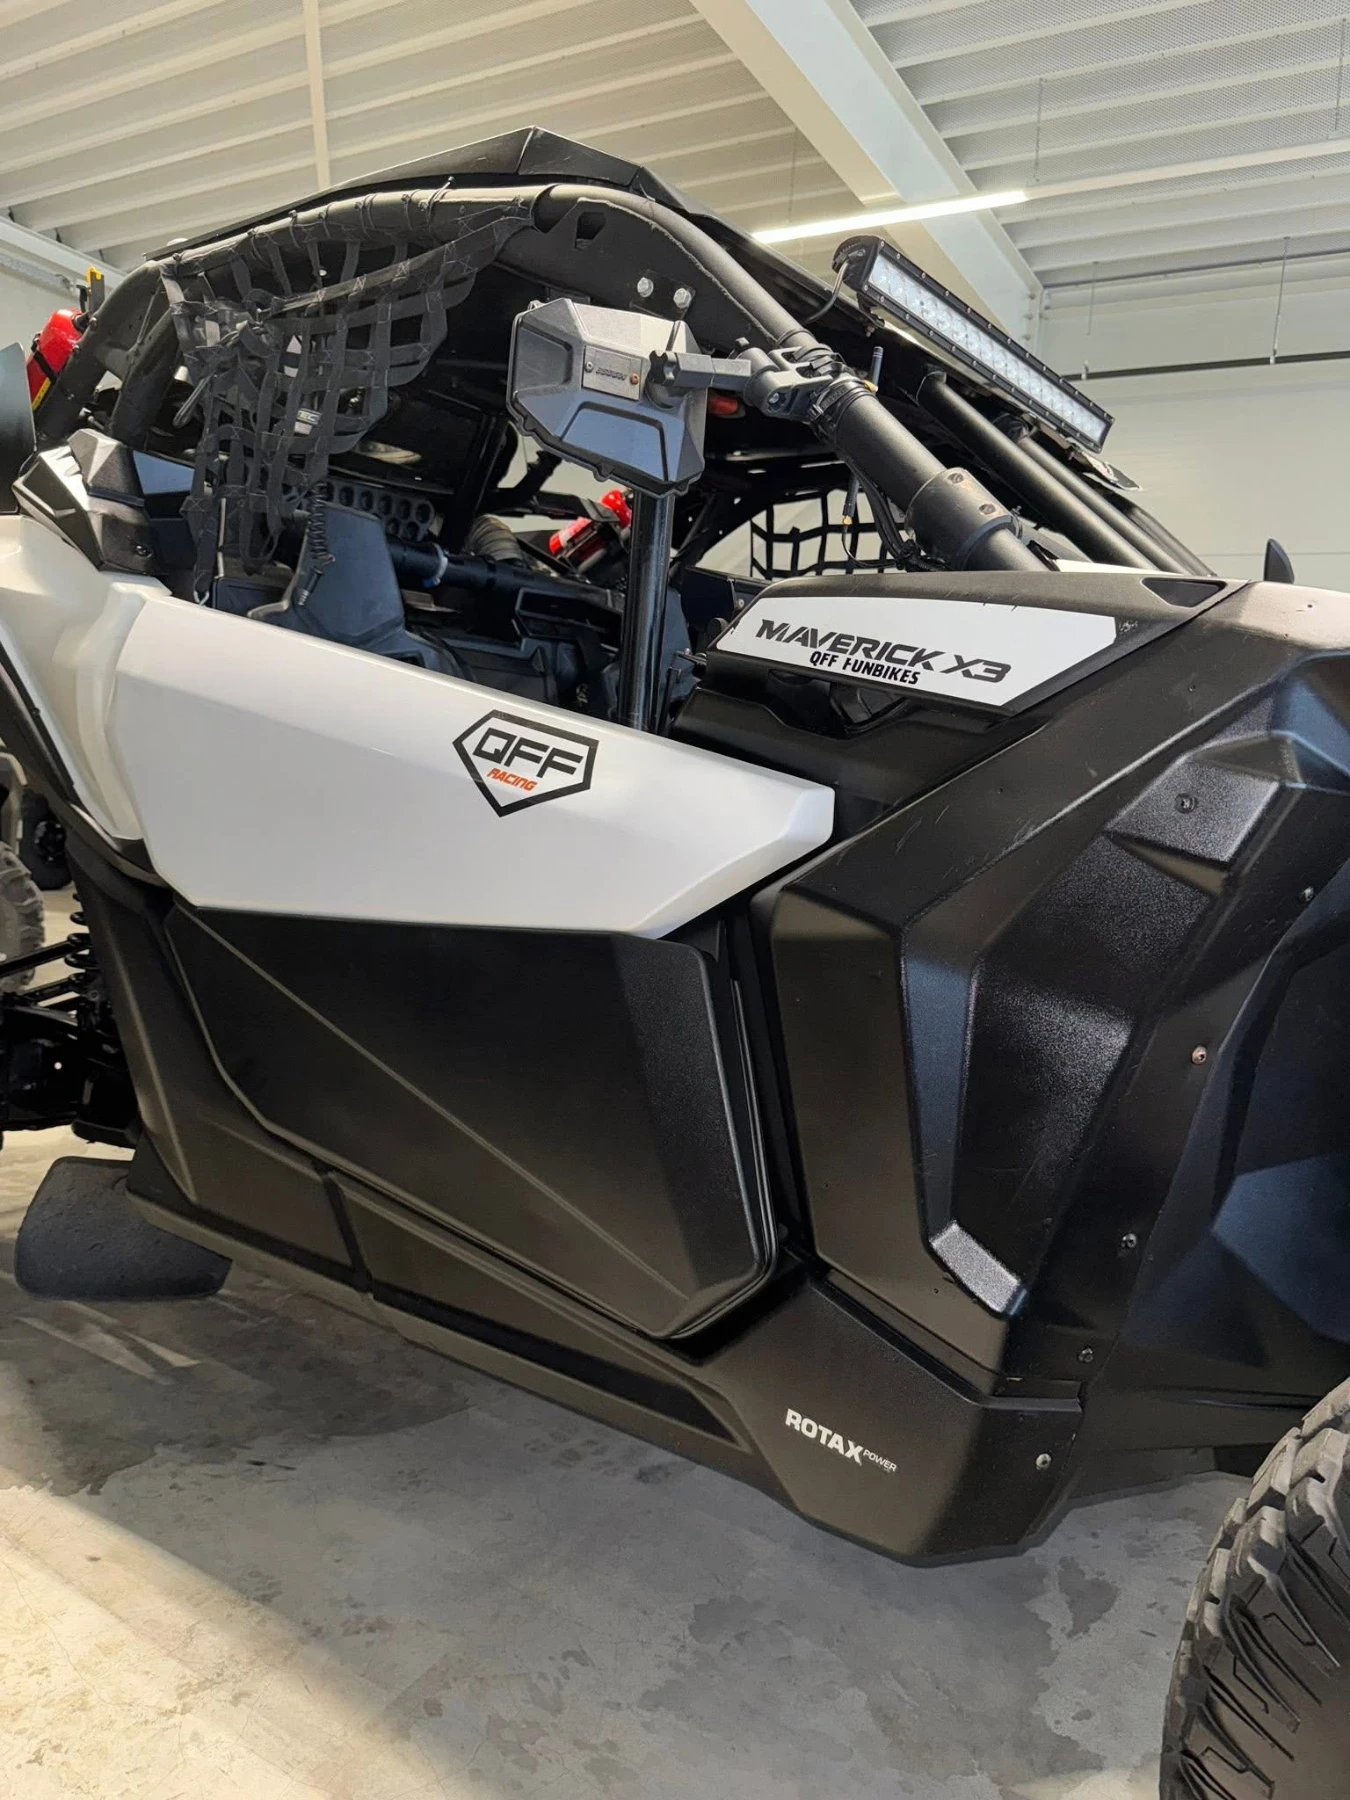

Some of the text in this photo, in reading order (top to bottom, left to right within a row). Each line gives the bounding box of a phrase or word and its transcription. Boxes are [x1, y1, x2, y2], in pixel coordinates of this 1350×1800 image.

[755, 619, 1012, 684] MAVERICK X3
[809, 651, 921, 685] QFF FUNBIKES
[472, 727, 584, 778] QFF
[487, 768, 538, 791] RACING
[785, 1408, 898, 1472] ROTAX POWER
